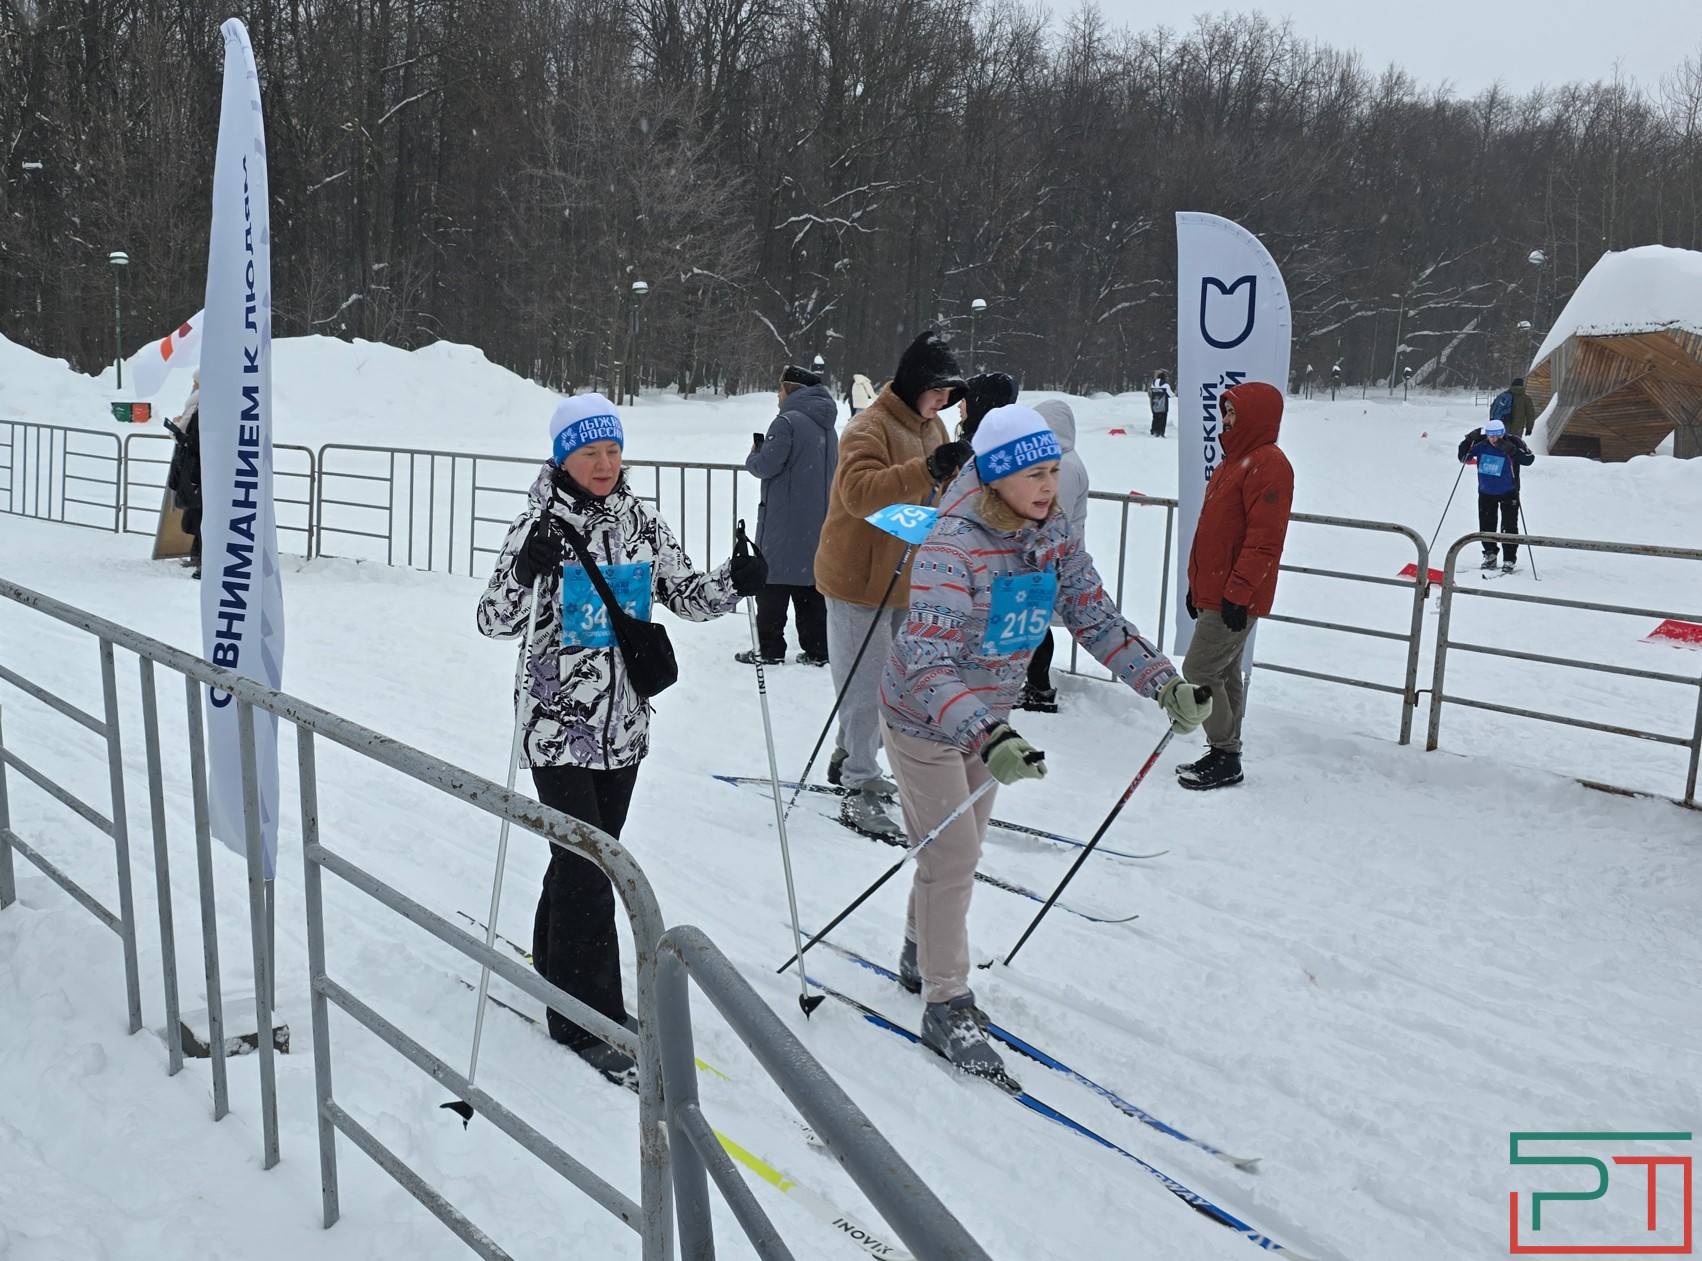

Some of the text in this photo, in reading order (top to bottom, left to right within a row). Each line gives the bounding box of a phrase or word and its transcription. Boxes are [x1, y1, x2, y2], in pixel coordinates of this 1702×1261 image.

[213, 386, 259, 668] ВНИМАНИЕМ
[243, 347, 259, 373] К
[580, 601, 637, 631] 345
[1000, 608, 1048, 640] 215
[832, 1217, 894, 1255] INOVIX
